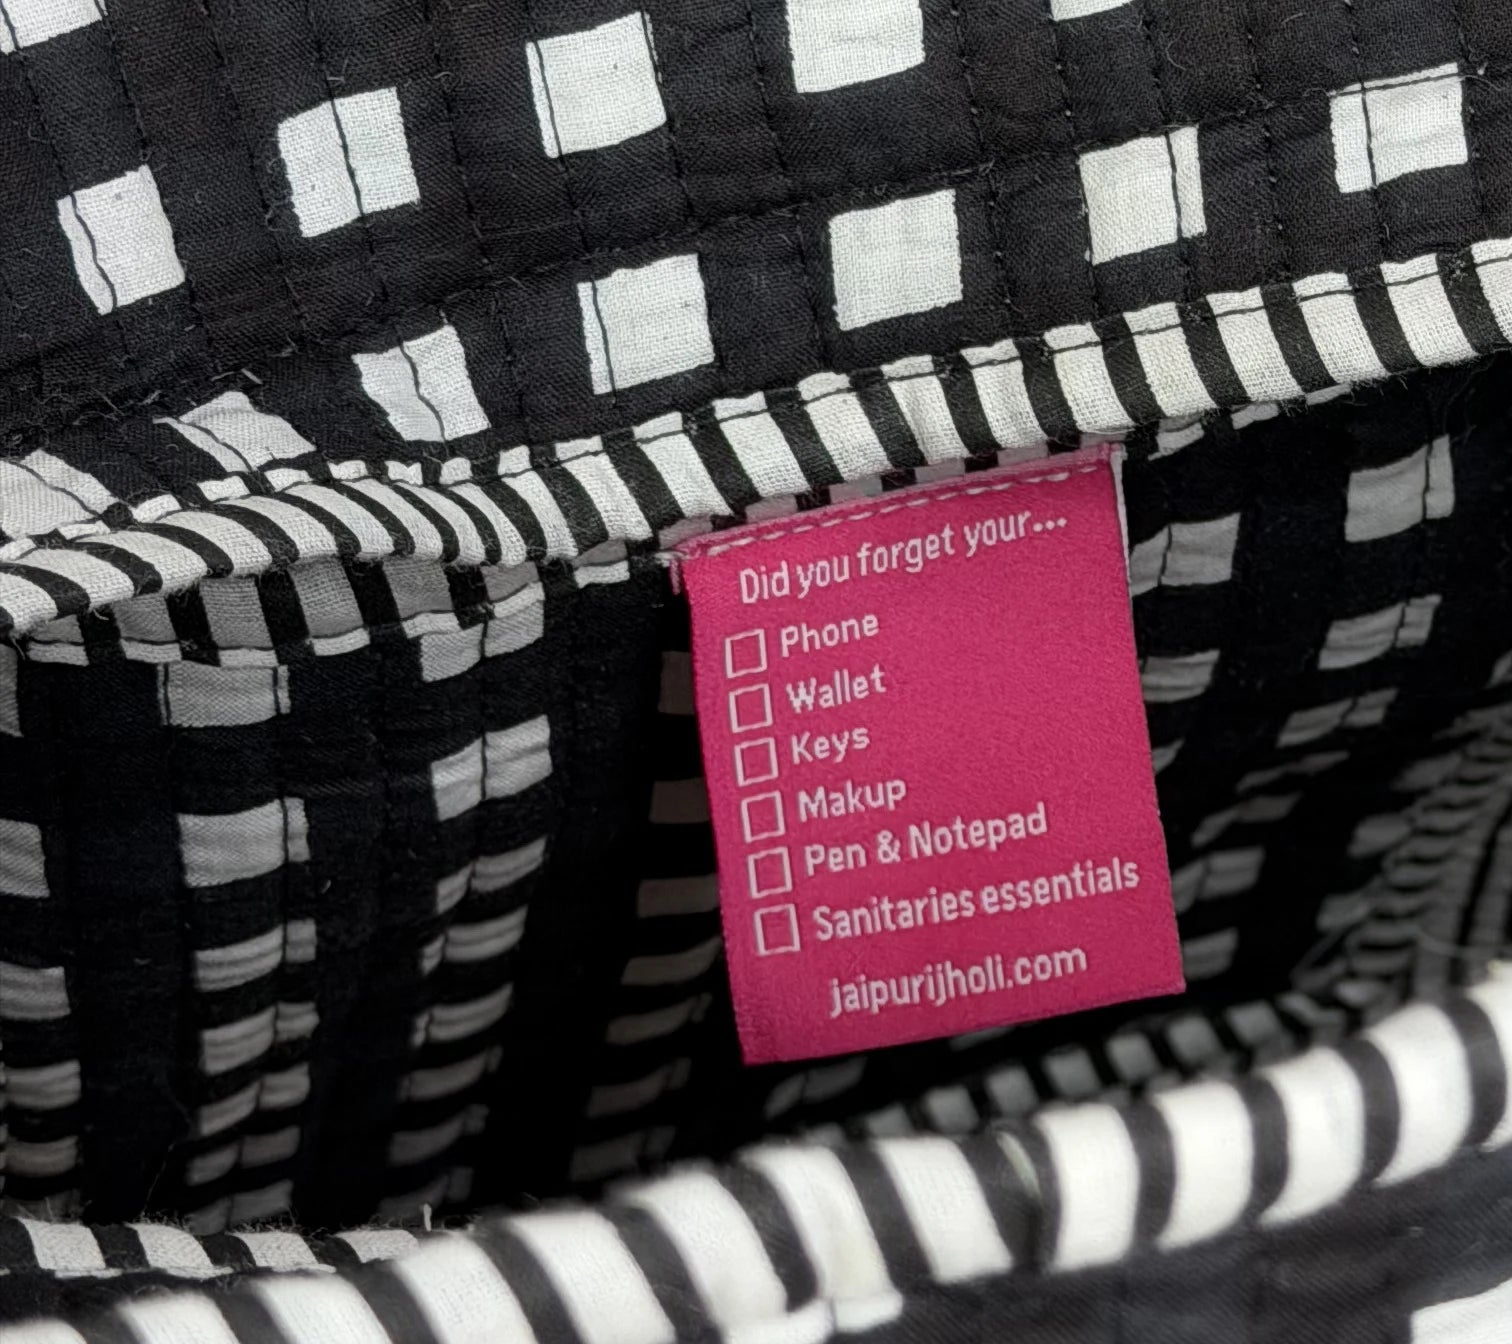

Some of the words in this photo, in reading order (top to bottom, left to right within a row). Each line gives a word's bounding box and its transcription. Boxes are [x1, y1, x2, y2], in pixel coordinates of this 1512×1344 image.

[740, 566, 790, 604] Did
[796, 558, 850, 599] you
[857, 525, 955, 573] forget
[780, 612, 880, 657] Phone
[786, 664, 887, 713] Wallet
[790, 726, 871, 765] Keys
[798, 778, 908, 823] Makup
[804, 840, 867, 876] Pen
[876, 830, 902, 863] &
[908, 803, 1049, 860] Notepad
[812, 886, 975, 942] Sanitaries
[980, 858, 1141, 916] essentials
[829, 946, 1088, 1018] jaipurijholi.com
